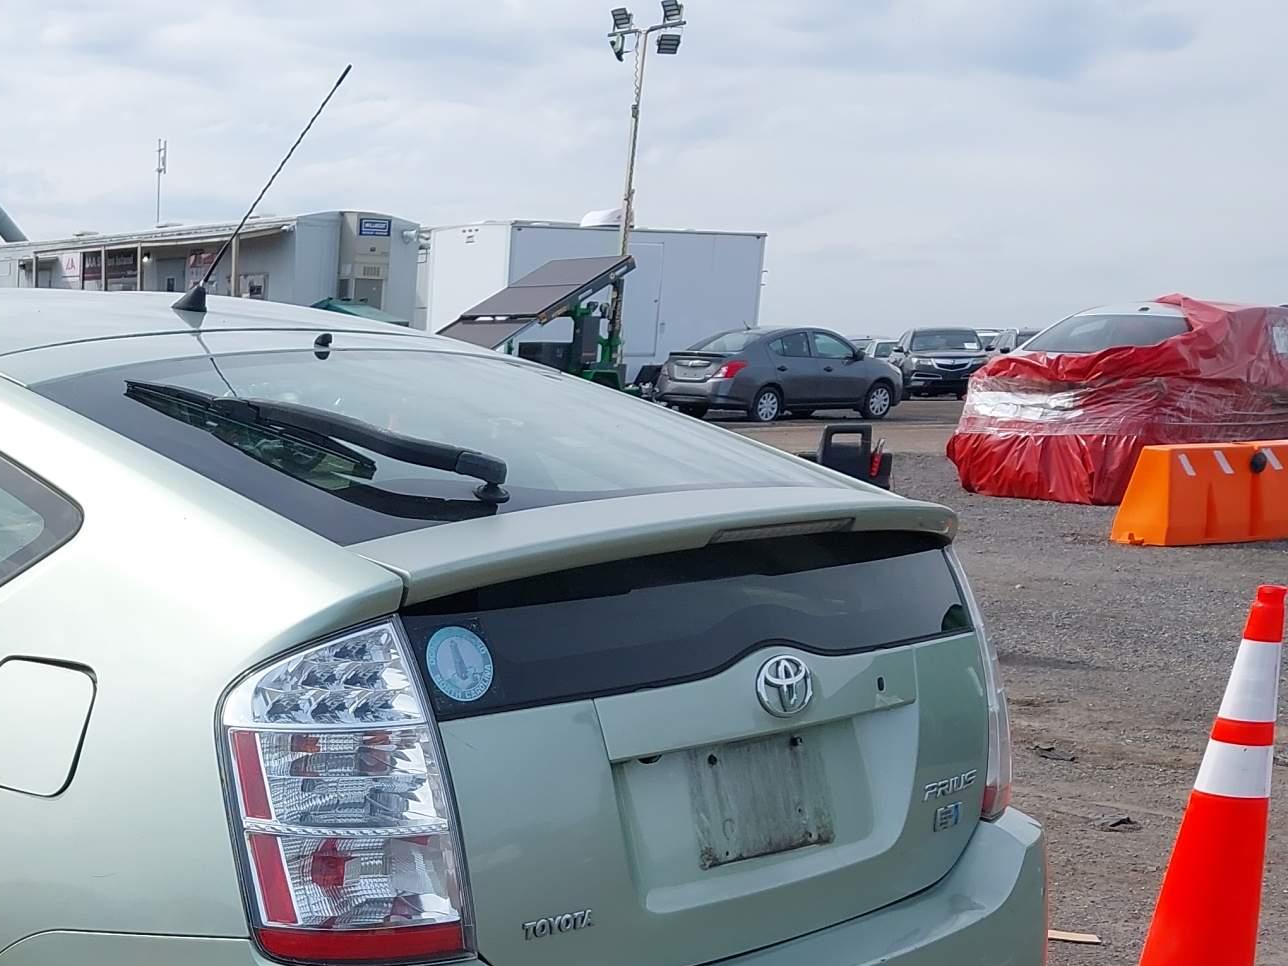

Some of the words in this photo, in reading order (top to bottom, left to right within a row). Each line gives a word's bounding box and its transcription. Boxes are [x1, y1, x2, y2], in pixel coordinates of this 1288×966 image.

[463, 664, 492, 699] CAROLINA
[923, 769, 977, 801] PRIUS
[521, 908, 594, 941] TOYOTA
